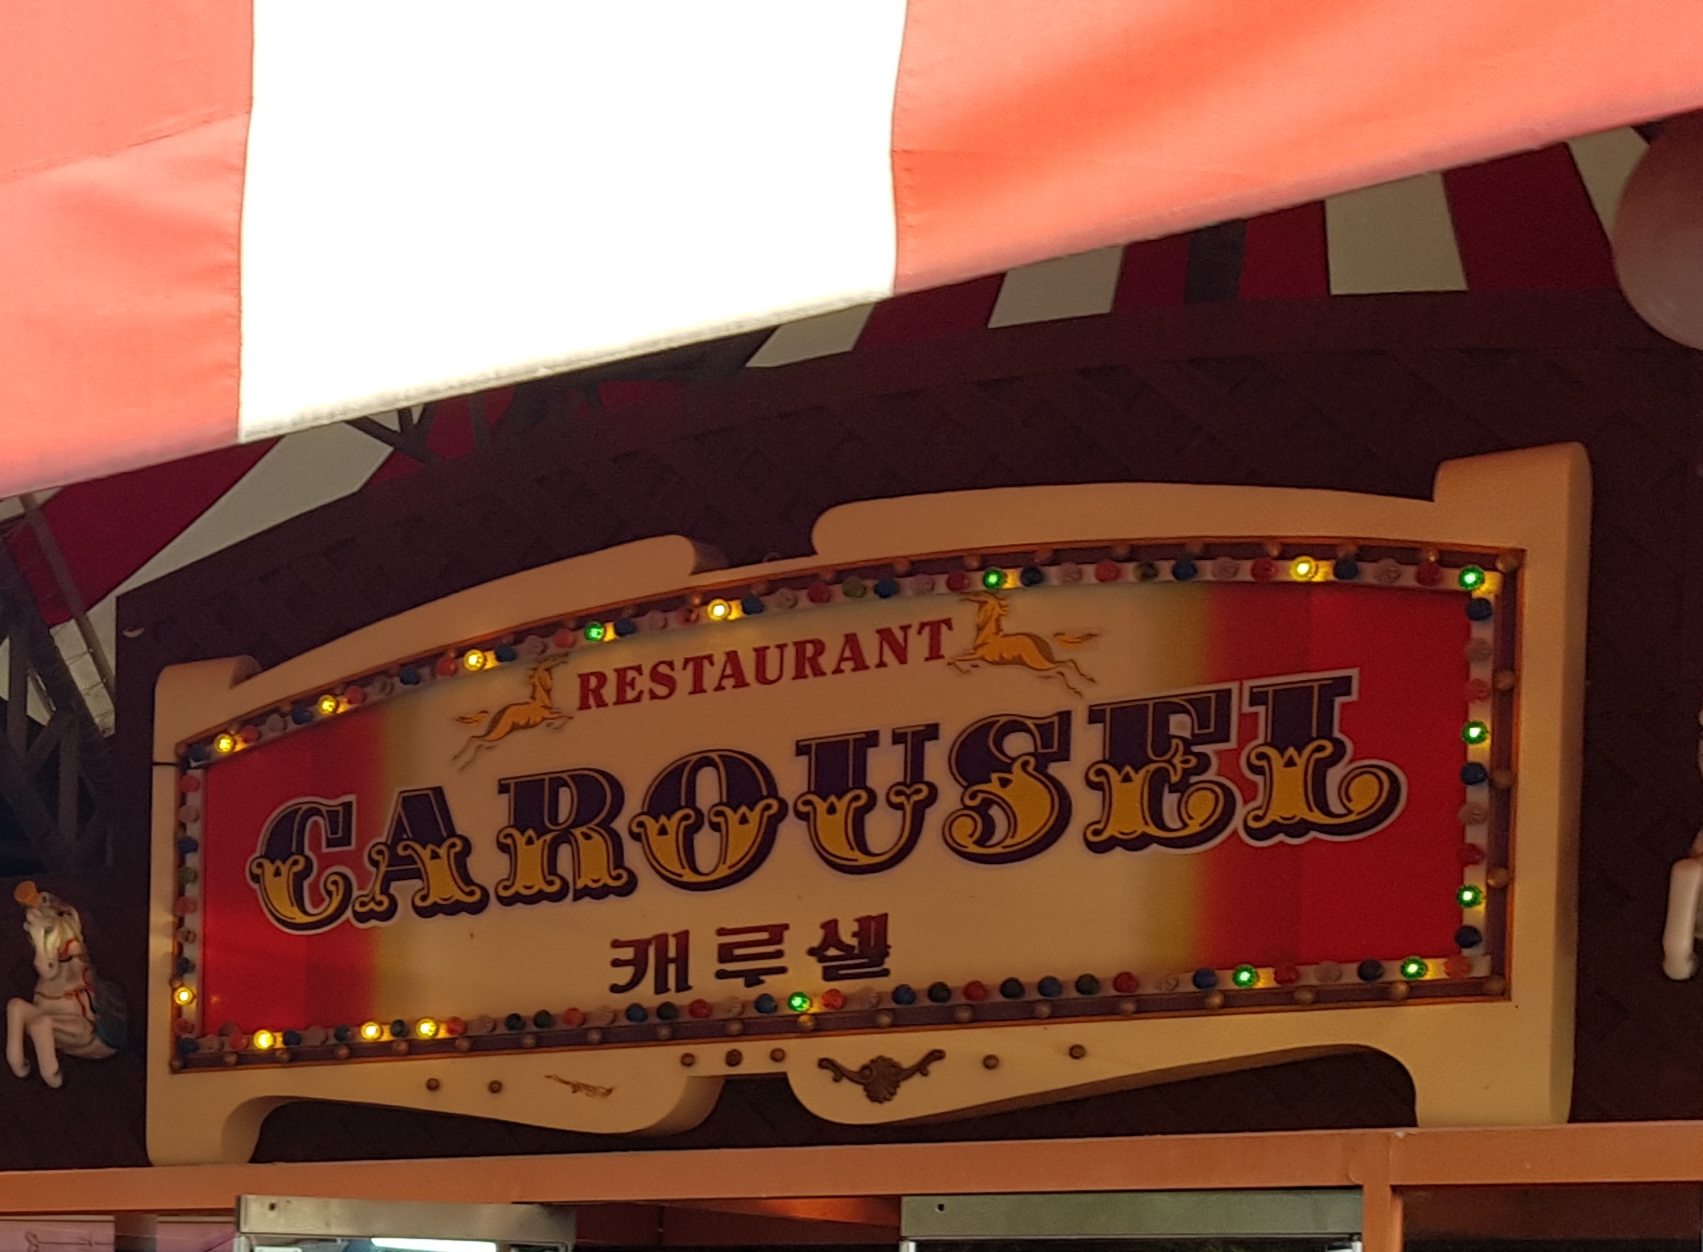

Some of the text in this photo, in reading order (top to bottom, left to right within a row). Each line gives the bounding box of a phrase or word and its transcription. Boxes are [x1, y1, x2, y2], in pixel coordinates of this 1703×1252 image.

[575, 616, 957, 712] RESTAURANT
[247, 668, 1405, 936] CAROUSEL
[610, 913, 891, 995] 캐루셀
